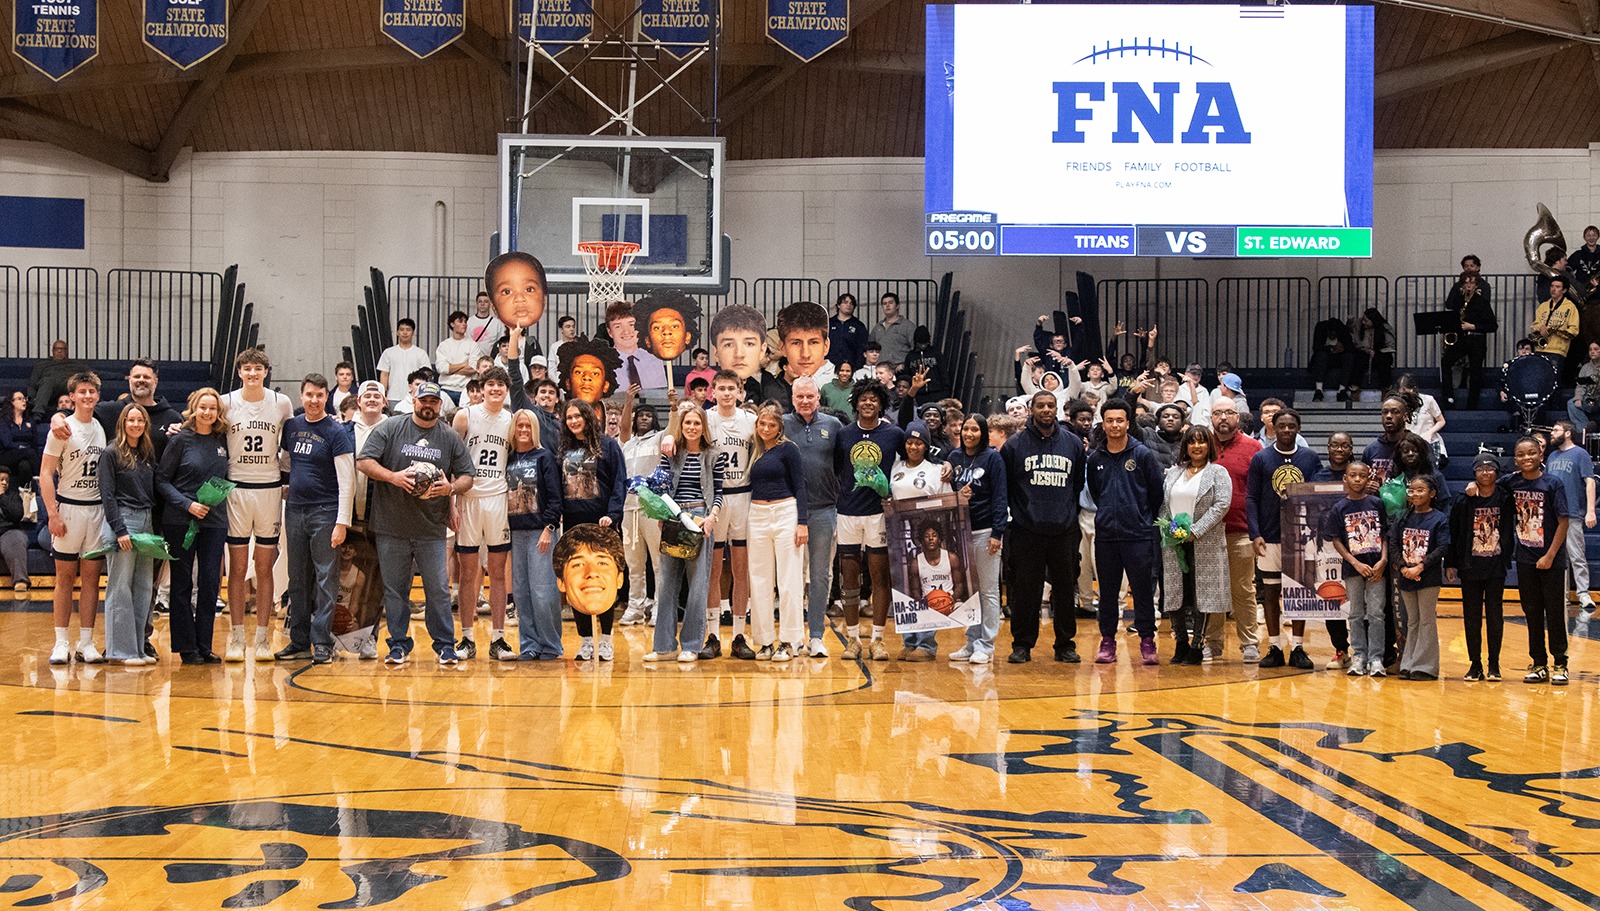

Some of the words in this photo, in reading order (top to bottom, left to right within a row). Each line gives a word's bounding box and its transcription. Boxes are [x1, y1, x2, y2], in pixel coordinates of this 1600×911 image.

[32, 5, 80, 16] TENNIS
[404, 0, 442, 11] STATE
[540, 0, 571, 12] TATE
[662, 0, 700, 12] STATE
[788, 2, 826, 15] STATE
[166, 8, 205, 22] STATE
[383, 13, 463, 27] CHAMPIONS
[519, 13, 591, 27] HMPIONS
[36, 18, 75, 32] STATE
[146, 22, 225, 37] CHAMPIONS
[768, 16, 846, 31] CHAMPIONS
[15, 33, 96, 48] CHAMPIONS
[1052, 82, 1251, 144] FNA
[1066, 162, 1112, 171] FRIENDS
[1124, 162, 1162, 171] FAMILY
[1174, 162, 1231, 172] FOOTBALL
[931, 214, 991, 223] PREGAME
[929, 231, 995, 250] 05:00
[1074, 235, 1129, 249] TITANS
[1165, 231, 1207, 253] VS
[1243, 237, 1265, 249] ST.
[1269, 237, 1340, 250] EDWARD
[231, 423, 243, 434] ST.
[247, 421, 276, 434] JOHN'S
[244, 436, 263, 452] 32
[469, 436, 481, 447] ST.
[70, 449, 83, 461] ST.
[294, 442, 313, 455] DAD
[237, 456, 270, 464] JESUIT
[479, 449, 498, 466] 22
[720, 452, 738, 467] 24
[1025, 455, 1039, 472] ST.
[1040, 454, 1072, 474] JOHN'S
[82, 460, 98, 477] 12
[475, 469, 502, 478] ESUIT
[523, 468, 536, 478] 22
[1030, 471, 1068, 487] JESUIT
[1513, 489, 1545, 501] TITANS
[1345, 510, 1379, 520] TITANS
[1404, 527, 1431, 537] TITANS
[1325, 568, 1337, 580] 10
[1283, 587, 1317, 599] KARTER
[894, 599, 929, 613] HA-SEAN
[1283, 599, 1340, 611] WASHINGTON
[896, 612, 918, 625] LAMB
